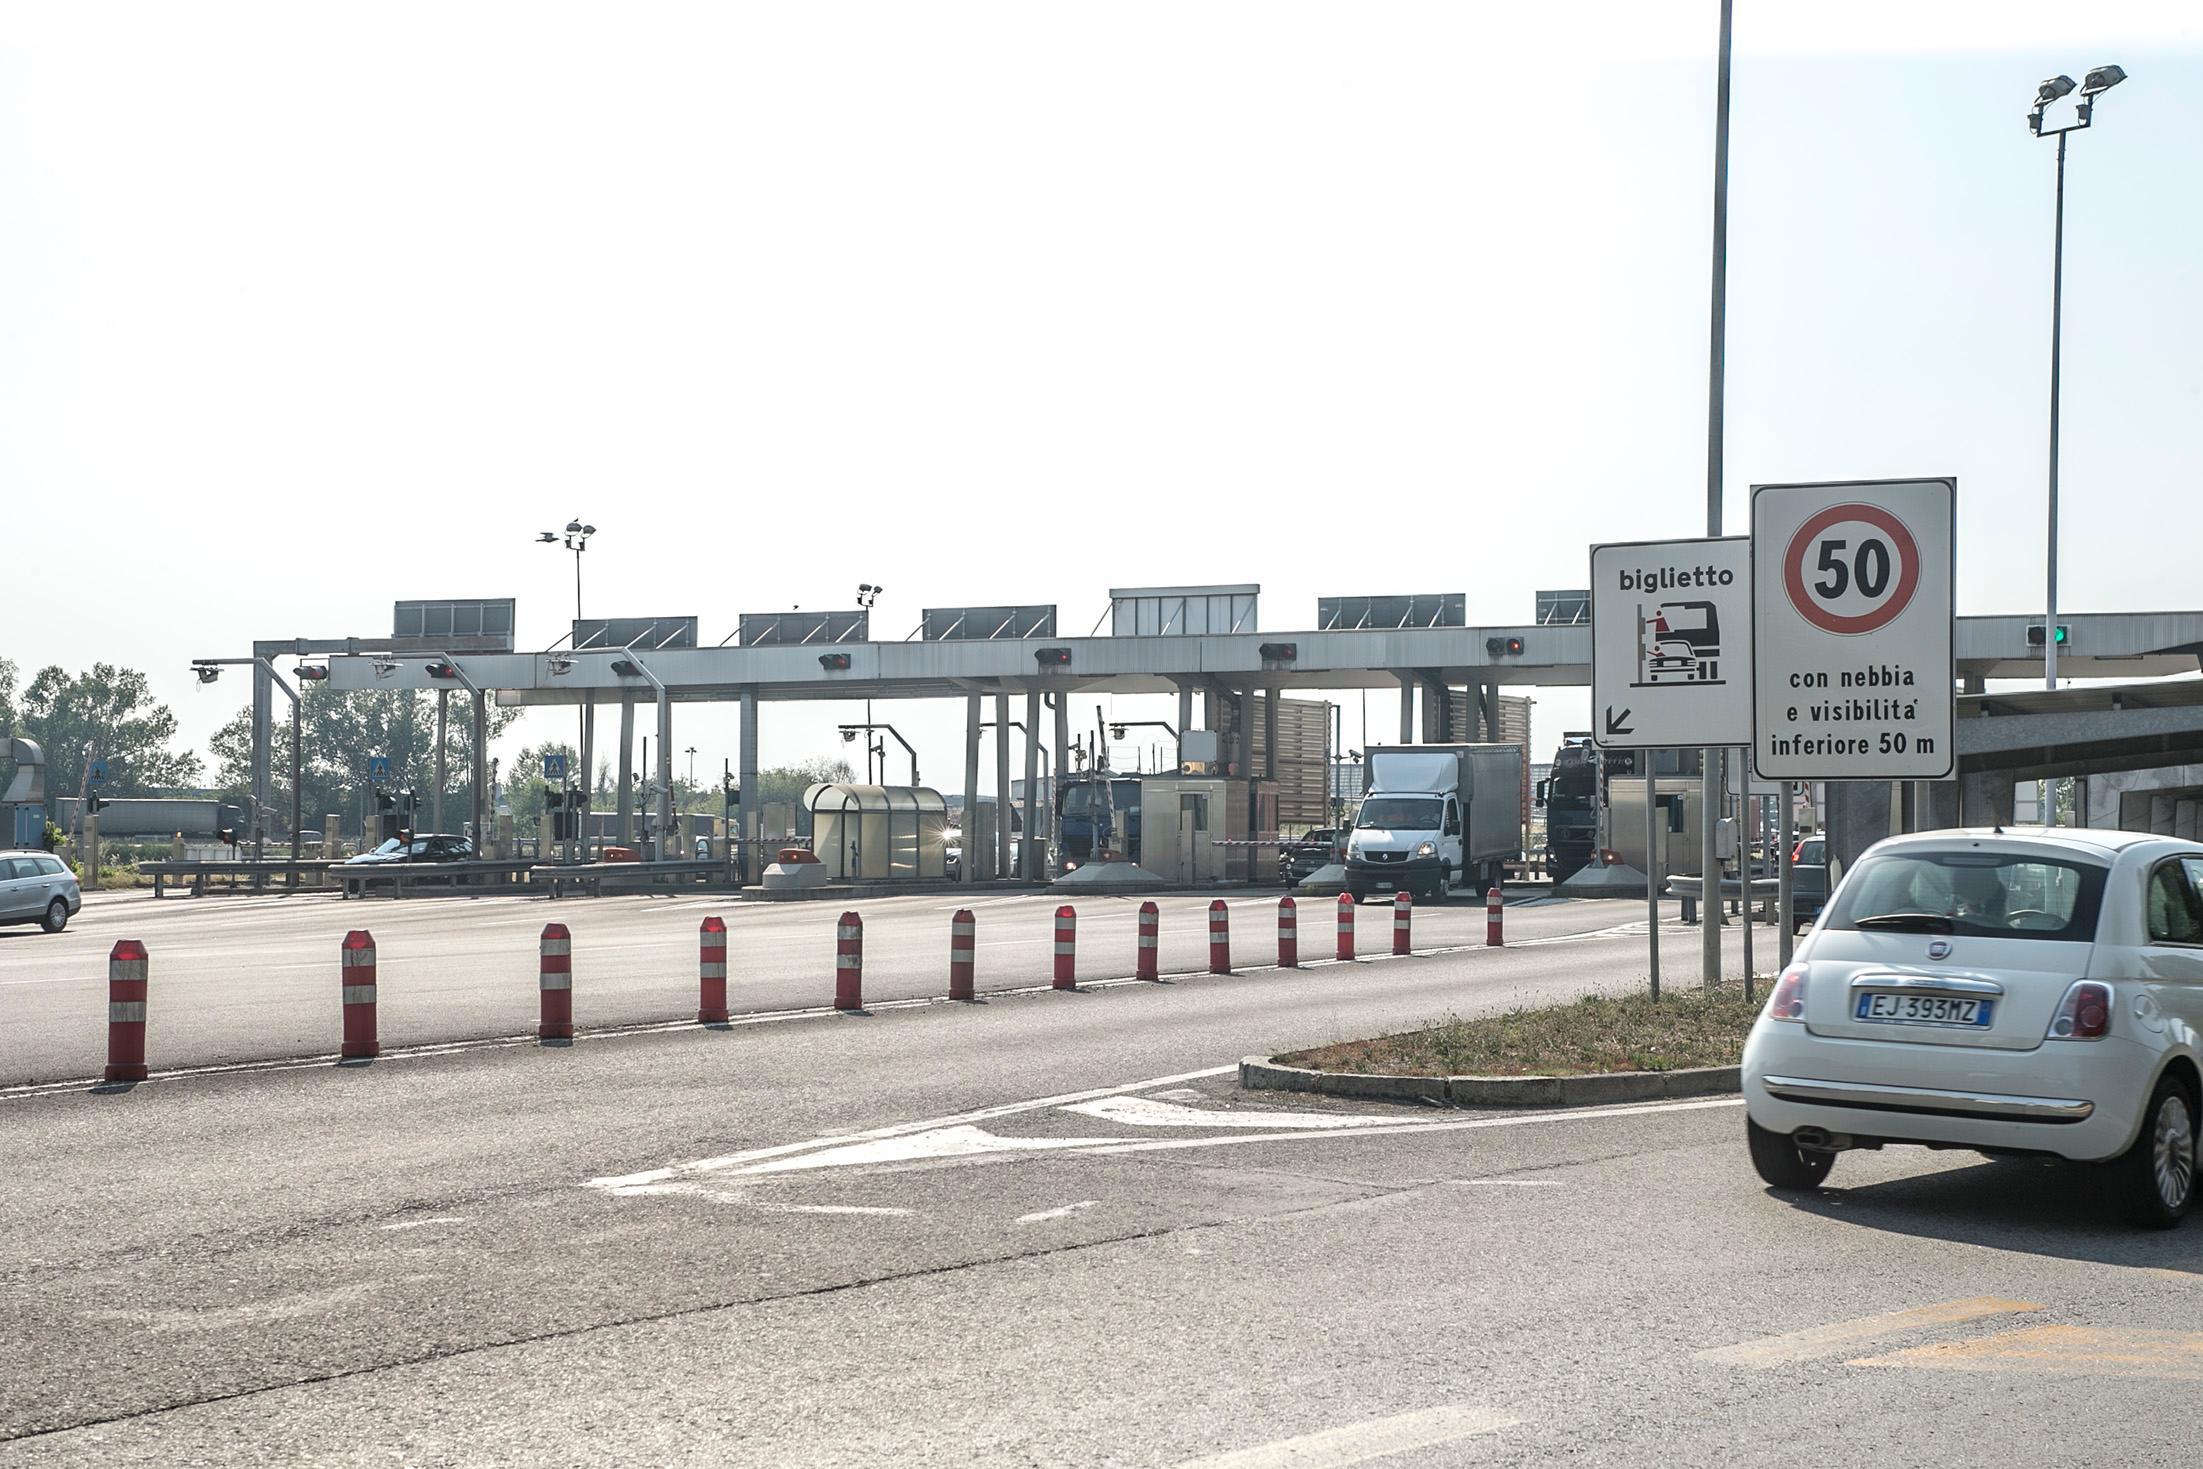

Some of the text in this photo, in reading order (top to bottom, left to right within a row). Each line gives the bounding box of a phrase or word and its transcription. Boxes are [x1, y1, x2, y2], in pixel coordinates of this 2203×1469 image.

[1619, 565, 1734, 594] biglietto
[1814, 538, 1891, 600] 50
[1789, 664, 1915, 689] con nebbia
[1786, 706, 1798, 722] e
[1771, 732, 1934, 756] inferiore 50 m
